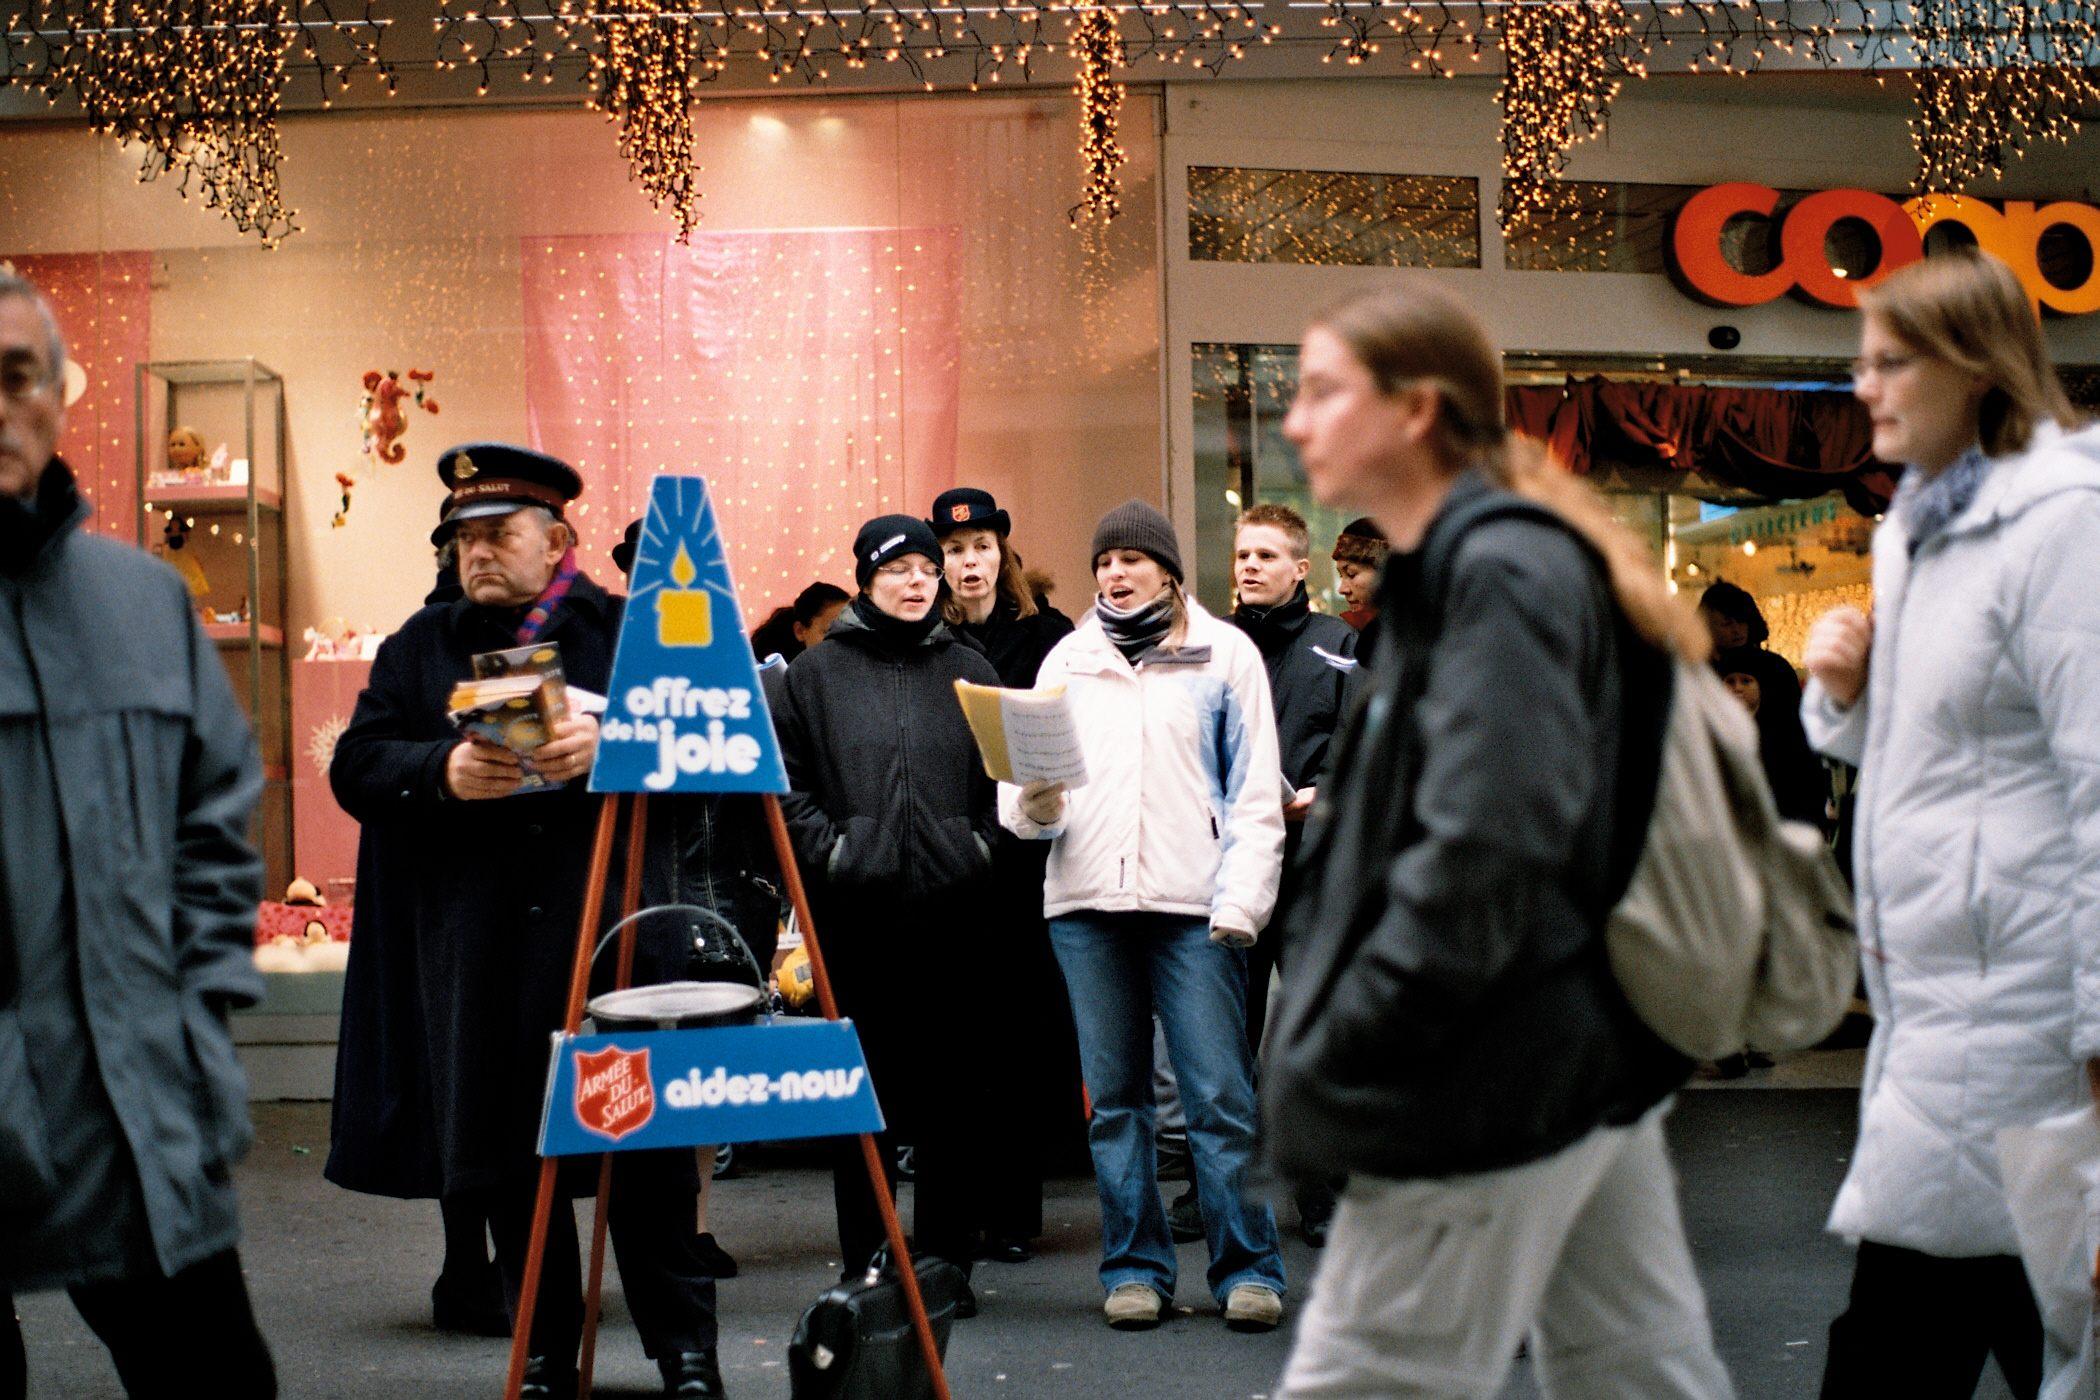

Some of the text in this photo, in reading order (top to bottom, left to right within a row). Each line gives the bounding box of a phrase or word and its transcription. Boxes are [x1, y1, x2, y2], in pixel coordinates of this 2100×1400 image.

[626, 676, 751, 718] offrez
[602, 718, 762, 790] de la joie
[610, 1074, 632, 1102] DU
[665, 1066, 864, 1108] aidez-nous
